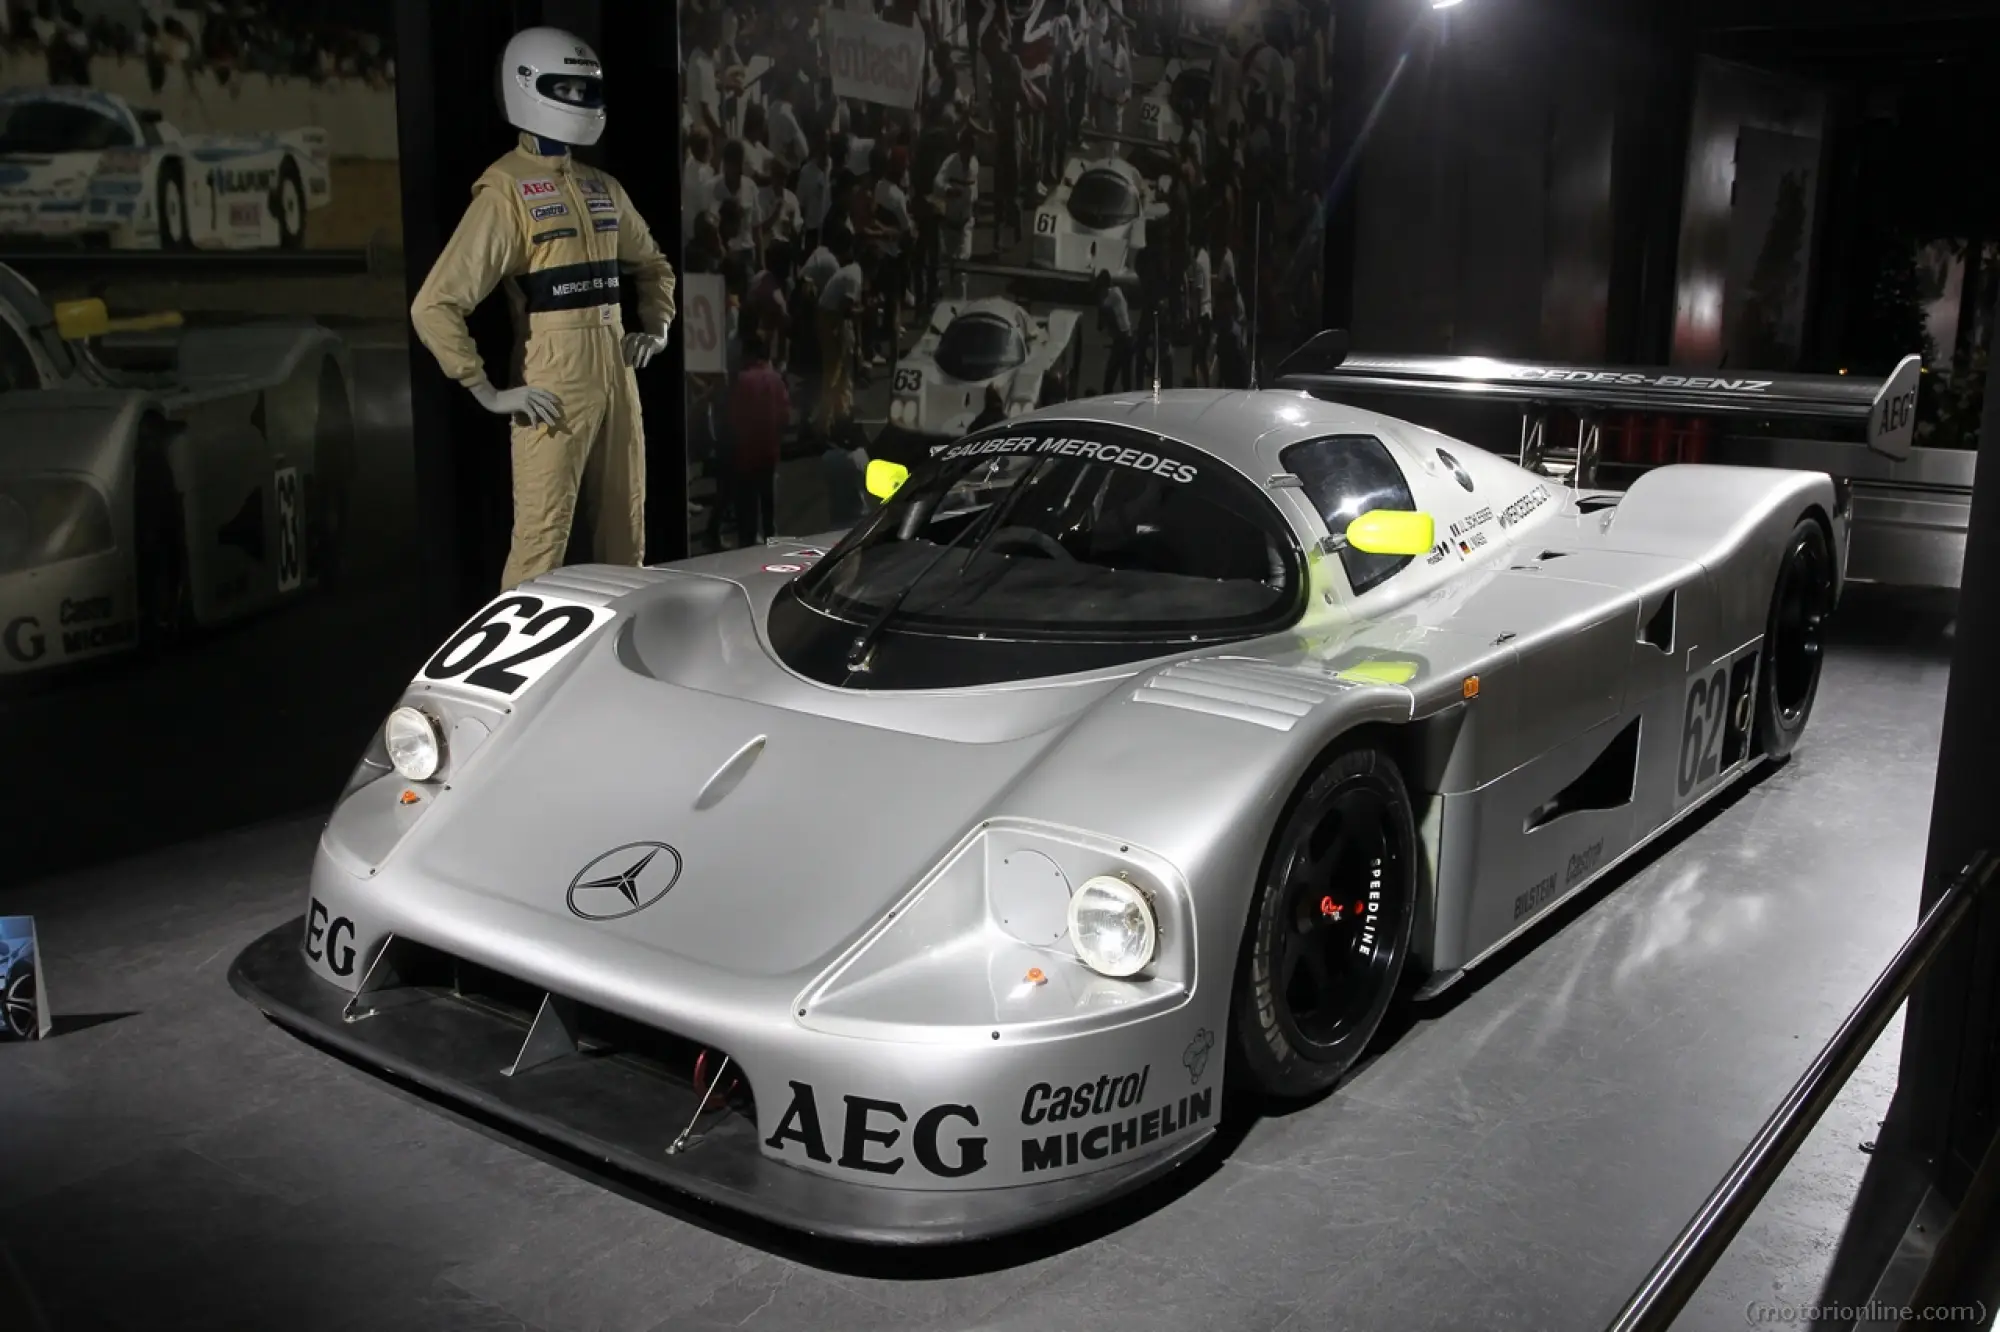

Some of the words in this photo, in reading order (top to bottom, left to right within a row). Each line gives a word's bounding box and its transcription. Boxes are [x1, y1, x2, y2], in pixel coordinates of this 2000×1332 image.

[522, 182, 556, 196] AEG
[1037, 213, 1057, 234] 61
[894, 368, 923, 391] 63
[1516, 367, 1774, 393] CEDES-BENZ
[1877, 392, 1911, 437] AEG
[941, 436, 1038, 461] SAUBER
[1036, 437, 1198, 483] MERCEDES
[424, 596, 595, 695] 62
[1677, 668, 1727, 797] 62
[1359, 858, 1382, 956] SPEEDLINE
[1021, 1065, 1150, 1126] Castrol
[765, 1079, 988, 1178] AEG
[1021, 1087, 1213, 1172] MICHELIN
